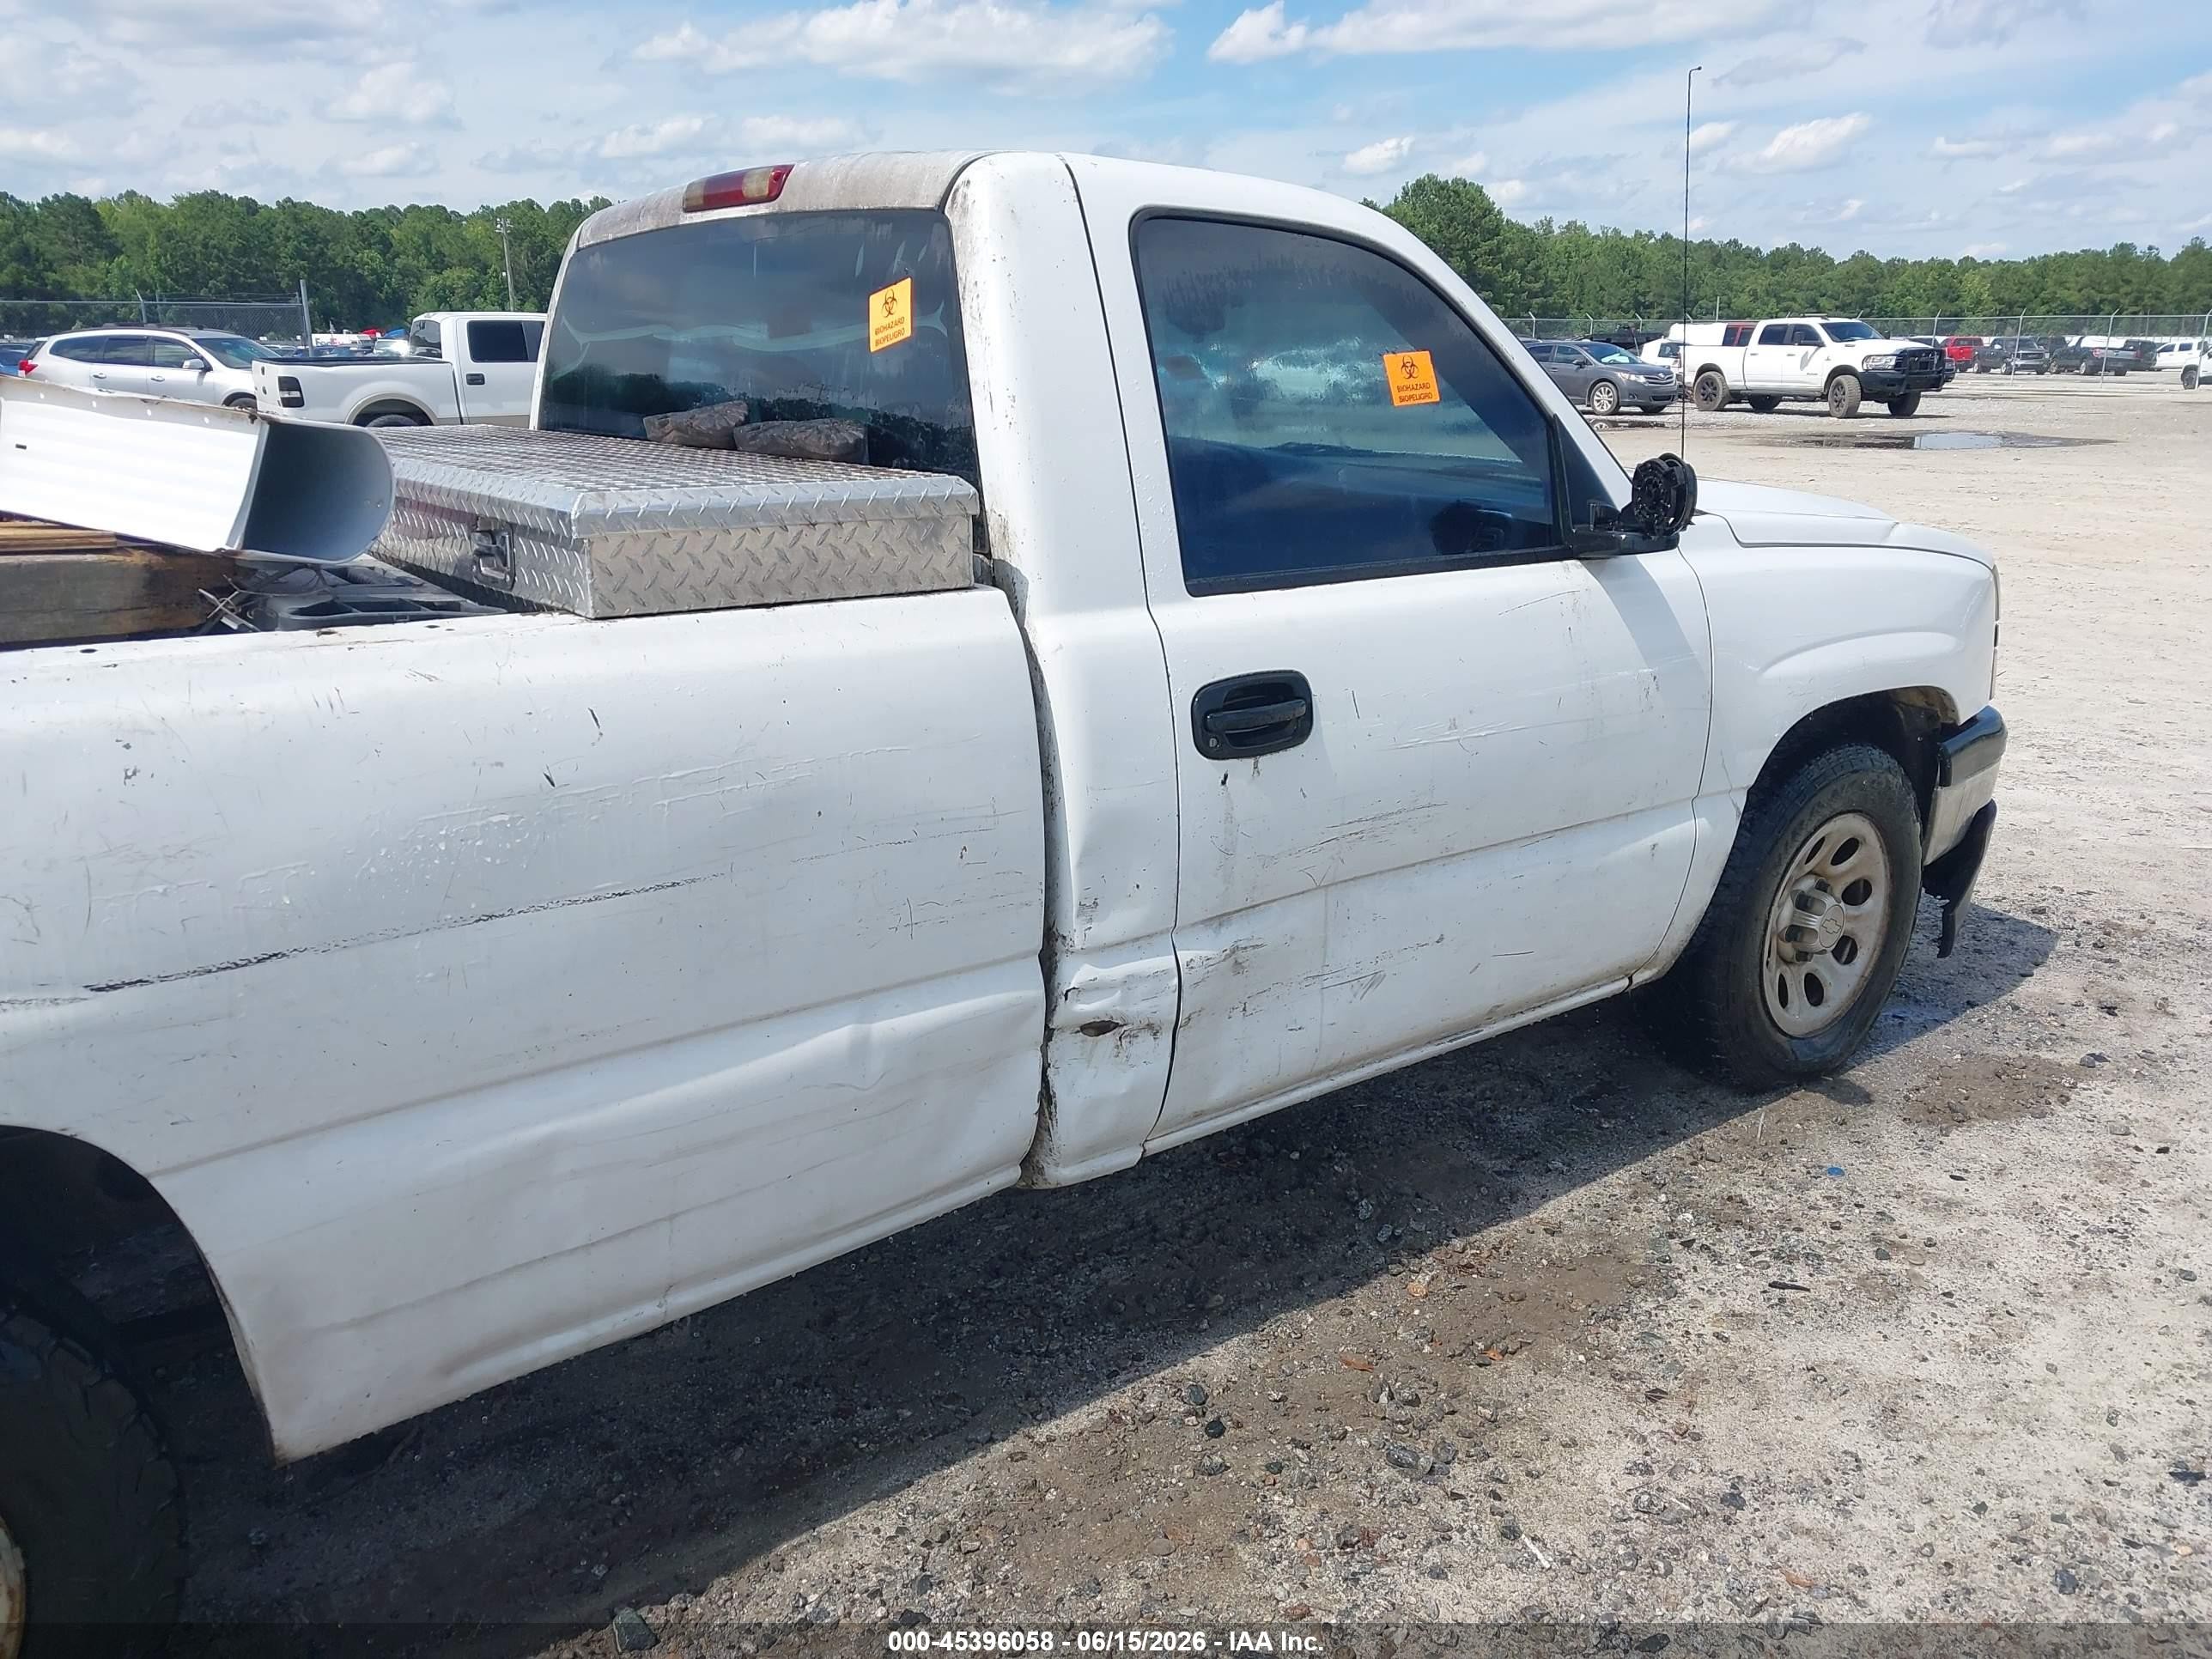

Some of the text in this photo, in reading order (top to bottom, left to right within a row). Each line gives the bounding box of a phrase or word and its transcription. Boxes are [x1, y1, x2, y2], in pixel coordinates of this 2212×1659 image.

[875, 317, 905, 335] BIOHAZARD
[875, 328, 906, 347] BIOPELIGRO
[1396, 382, 1431, 393] BIOHAZARD
[1399, 392, 1433, 403] BIOPELIGRO
